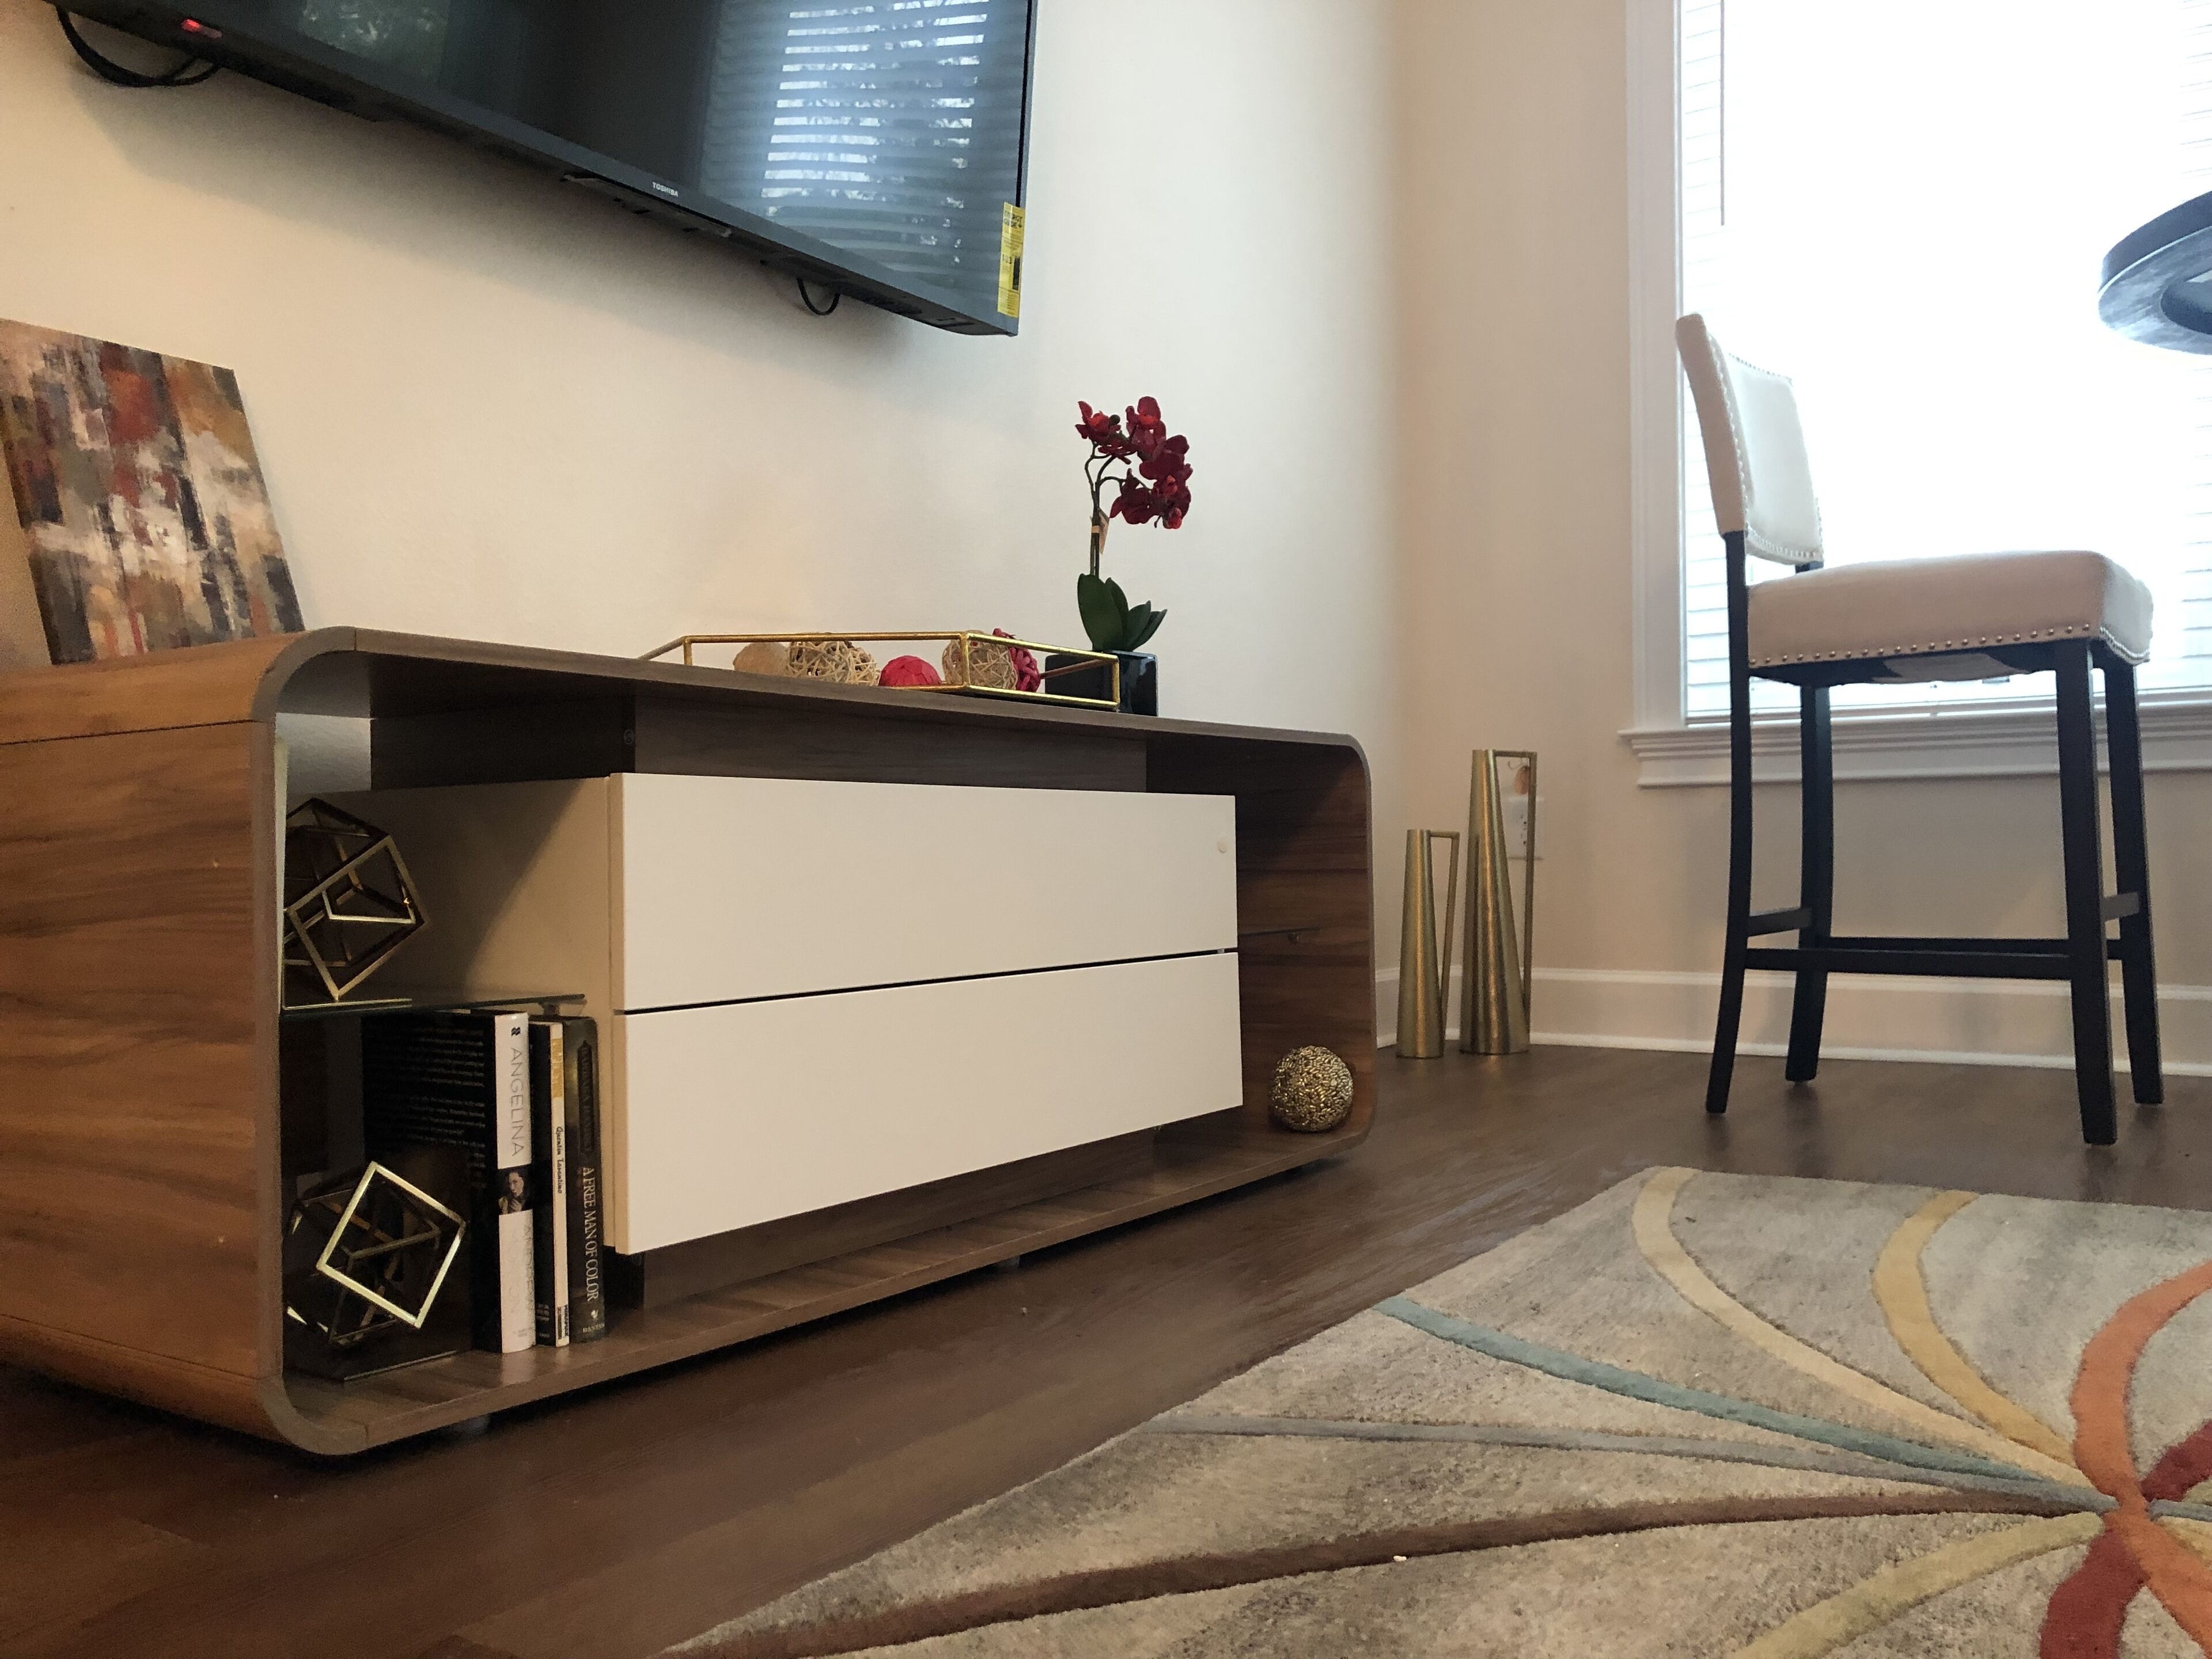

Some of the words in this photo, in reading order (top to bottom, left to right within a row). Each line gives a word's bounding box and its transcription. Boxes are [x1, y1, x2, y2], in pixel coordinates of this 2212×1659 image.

[652, 181, 678, 197] TOSHIBA
[510, 1047, 524, 1157] ANGELINA
[583, 1167, 594, 1176] A
[584, 1177, 596, 1208] FREE
[584, 1210, 597, 1239] MAN
[585, 1240, 597, 1256] OF
[586, 1259, 599, 1301] COLOR
